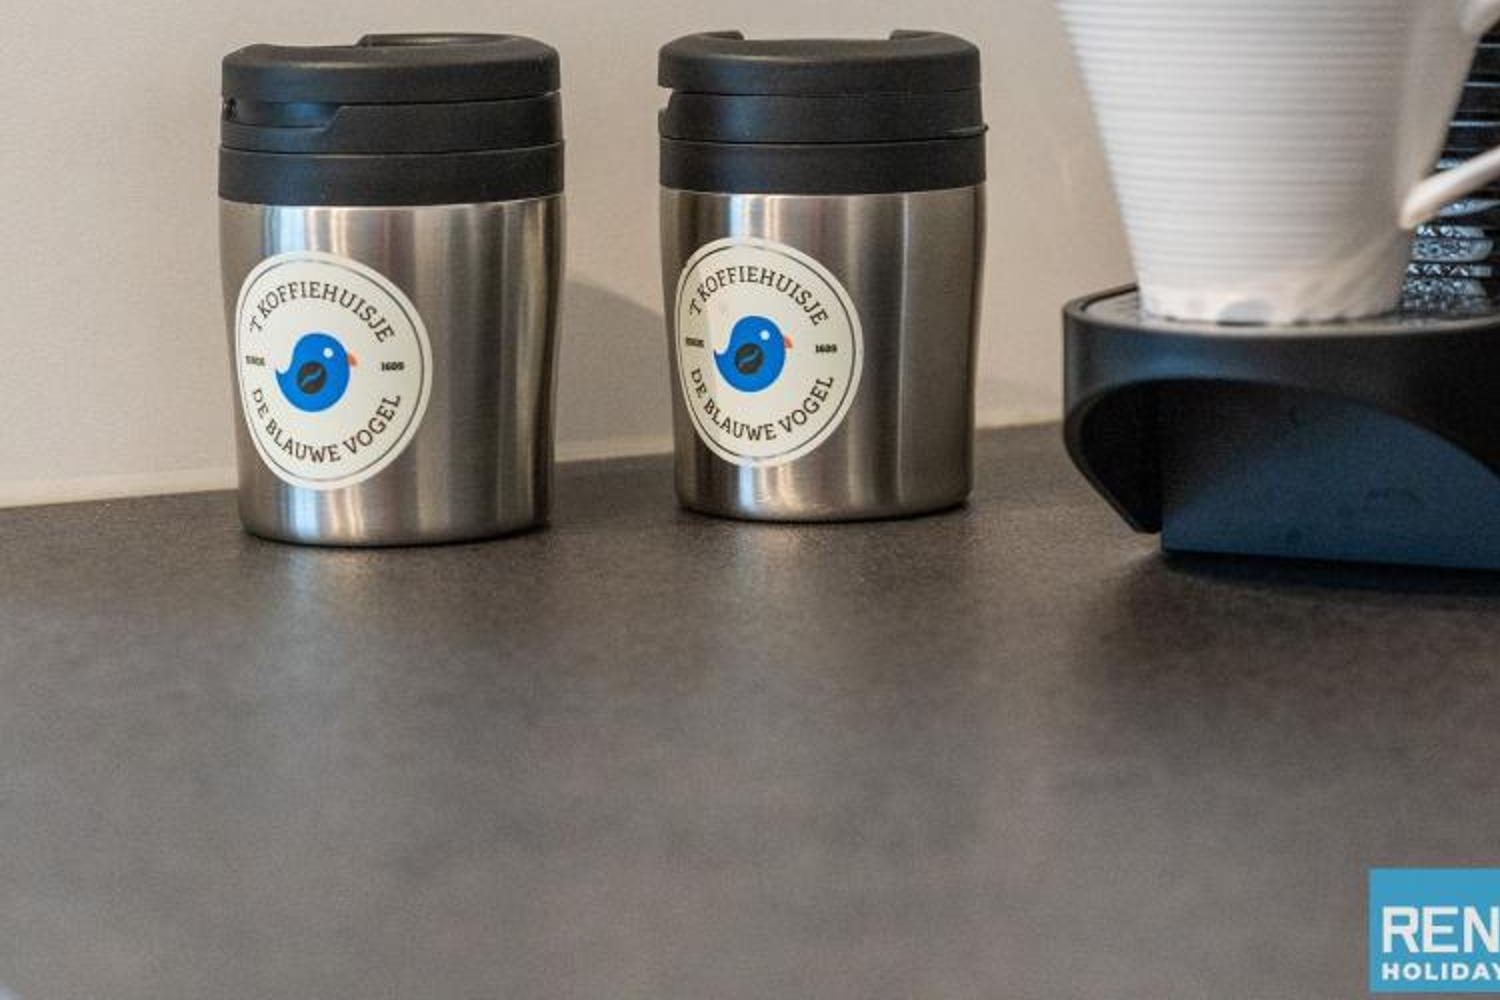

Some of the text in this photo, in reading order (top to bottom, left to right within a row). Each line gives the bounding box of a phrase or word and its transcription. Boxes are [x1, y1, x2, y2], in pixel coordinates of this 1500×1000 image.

[257, 280, 396, 343] KOFFIEHUISJE
[697, 264, 829, 326] KOFFIEHUISJE
[252, 387, 402, 464] DE BLAUWE VOGEL
[691, 367, 835, 442] DE BLAUWE VOGEL
